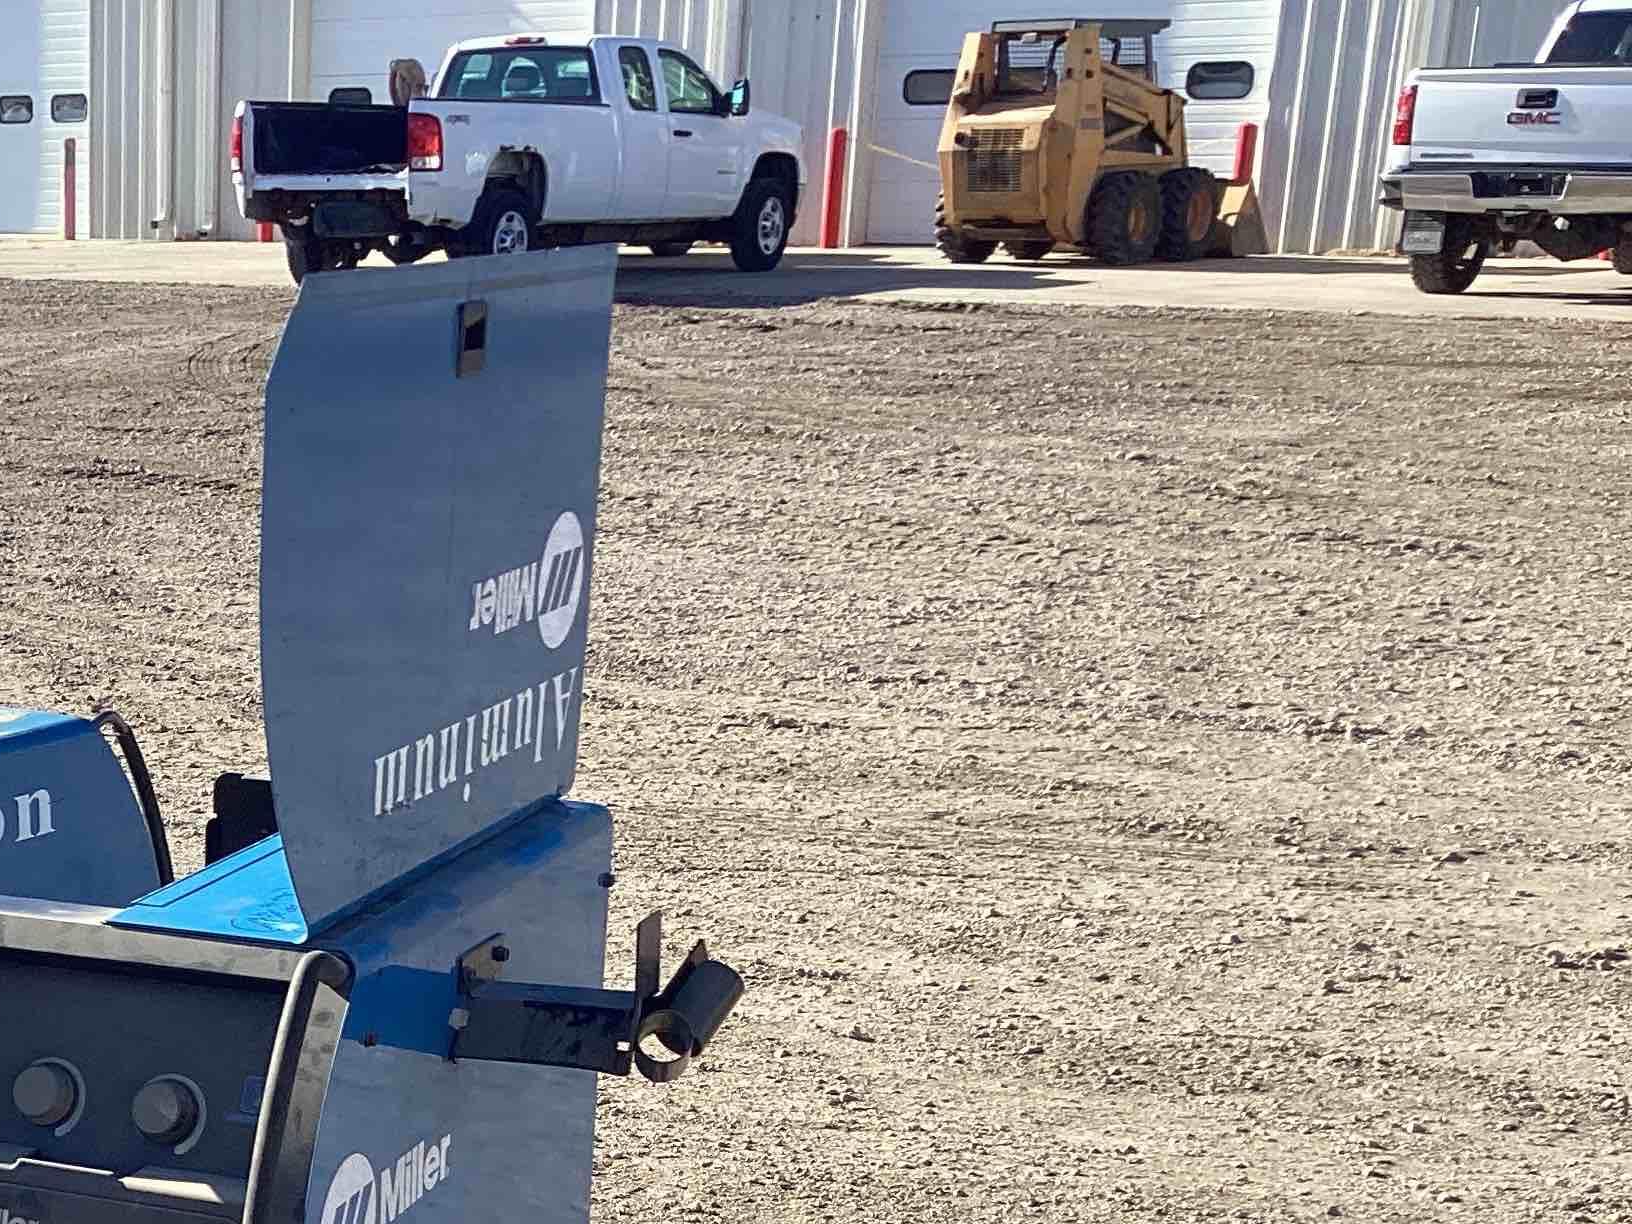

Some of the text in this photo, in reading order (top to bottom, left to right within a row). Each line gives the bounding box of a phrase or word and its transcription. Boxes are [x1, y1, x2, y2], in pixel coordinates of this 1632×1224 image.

[1506, 112, 1561, 125] GMC
[469, 562, 538, 635] Miller
[374, 667, 579, 816] Aluminum
